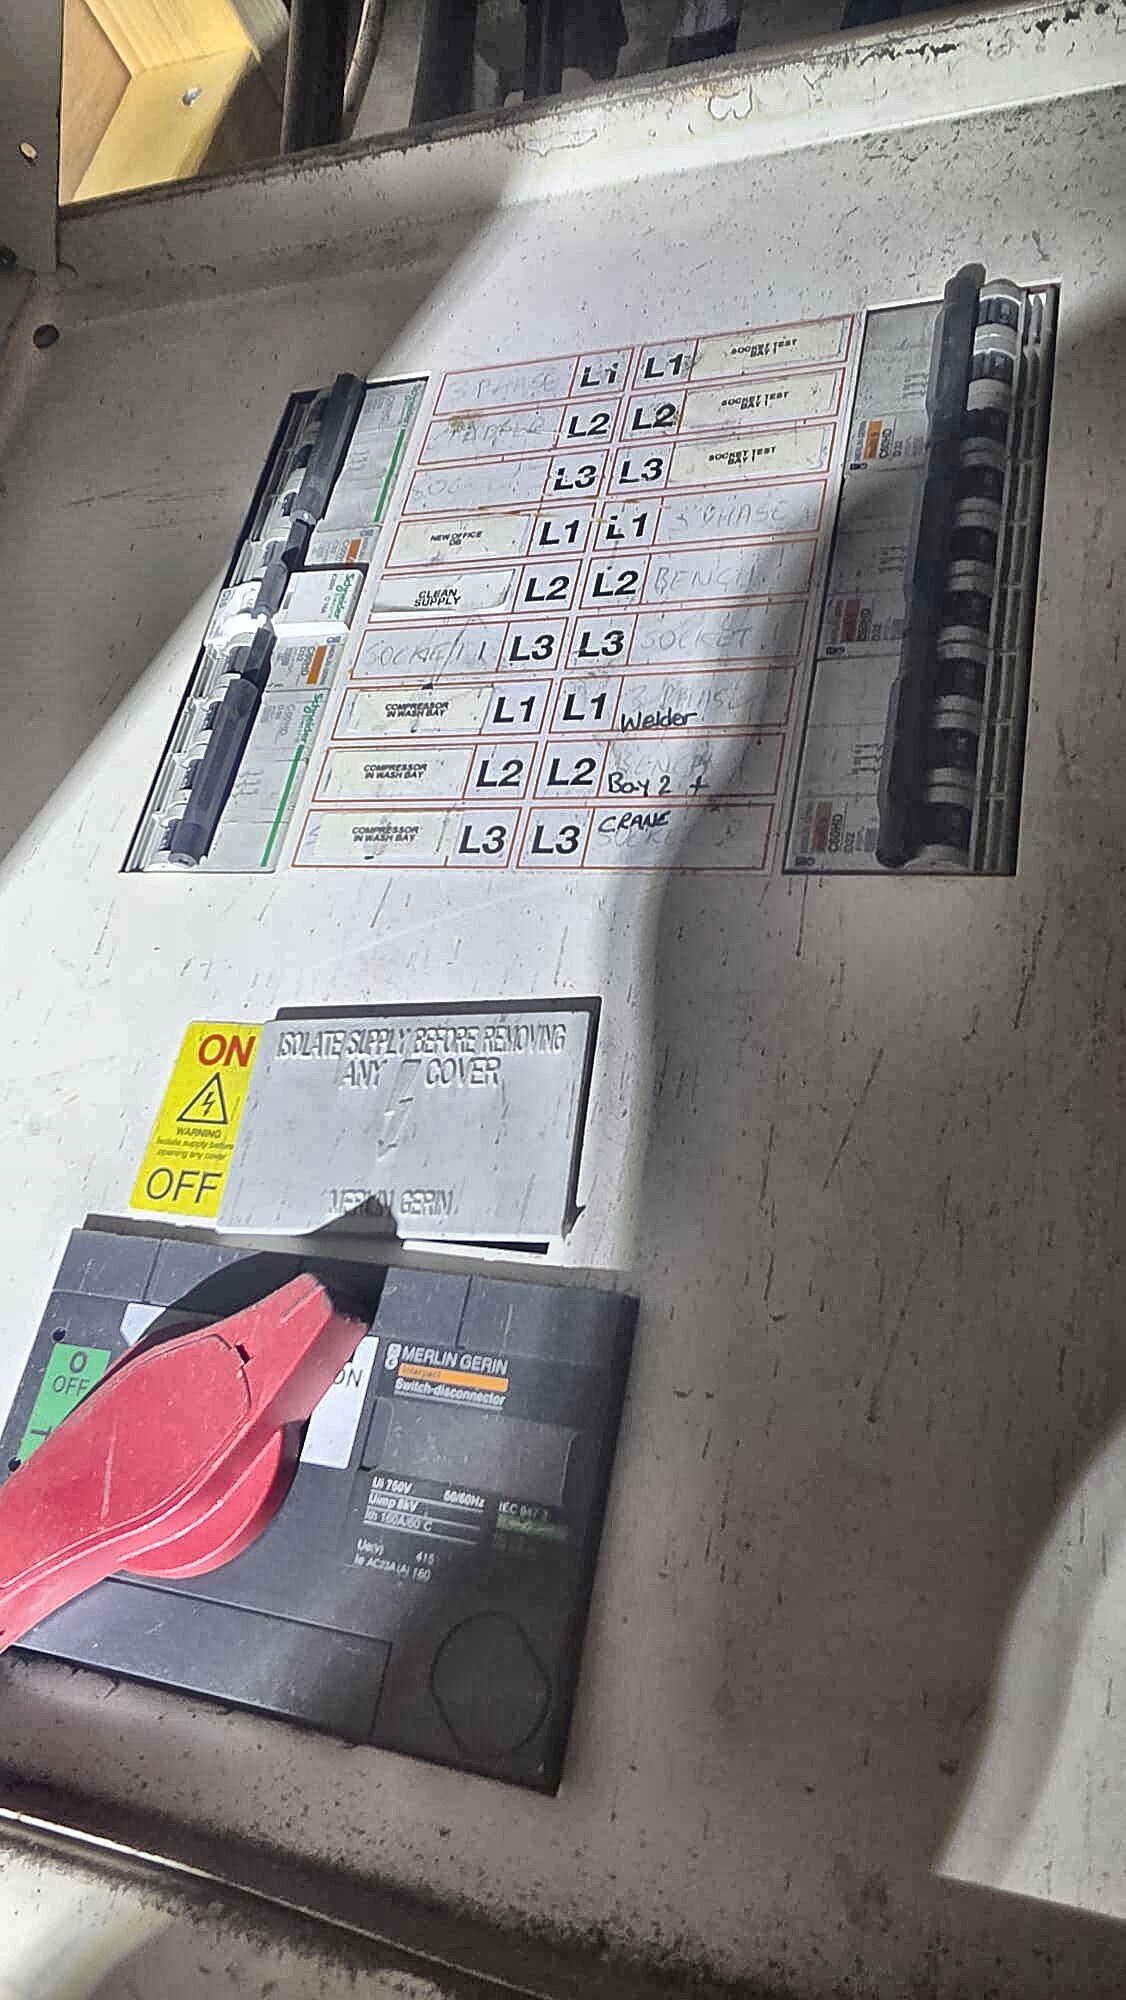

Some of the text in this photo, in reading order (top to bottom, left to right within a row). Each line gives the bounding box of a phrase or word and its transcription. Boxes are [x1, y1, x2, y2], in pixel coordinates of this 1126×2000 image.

[644, 354, 684, 379] L1
[566, 412, 611, 439] L2
[631, 403, 677, 431] L2
[554, 465, 598, 491] L3
[618, 457, 664, 484] L3
[430, 530, 483, 543] NEW OFFICE
[539, 519, 580, 546] L1
[605, 513, 649, 540] L1
[418, 588, 459, 600] CLEAN
[523, 575, 571, 603] L2
[592, 570, 639, 598] L2
[413, 595, 462, 608] SUPPLY
[508, 634, 556, 663] L3
[577, 629, 625, 658] L3
[385, 701, 450, 712] COMPRESSOR
[386, 707, 447, 719] IN WASH BAY
[492, 695, 536, 724] L1
[562, 692, 607, 722] L1
[620, 707, 698, 733] Welder
[363, 763, 428, 774] COMPRESSOR
[364, 770, 425, 780] IN WASH BAY
[475, 759, 524, 788] L2
[546, 757, 597, 787] L2
[608, 771, 651, 798] Bay
[658, 775, 672, 795] 2
[352, 826, 420, 836] COMPRESSOR
[598, 809, 672, 833] CRANE
[353, 833, 365, 843] IN
[394, 832, 417, 843] BAY
[458, 824, 508, 854] L3
[530, 824, 581, 855] L3
[198, 1033, 257, 1068] ON
[275, 1022, 568, 1060] ISOLATE SUPPLY BEFORE REMOVING
[338, 1055, 502, 1089] ANY COVER
[176, 1127, 222, 1140] WARNING
[146, 1167, 224, 1205] OFF
[400, 1188, 455, 1217] GERIN
[401, 1344, 459, 1368] MERLIN
[459, 1352, 509, 1376] GERIN
[52, 1375, 91, 1398] OFF
[394, 1377, 507, 1406] Switch-disconnector
[368, 1492, 397, 1509] Uimp
